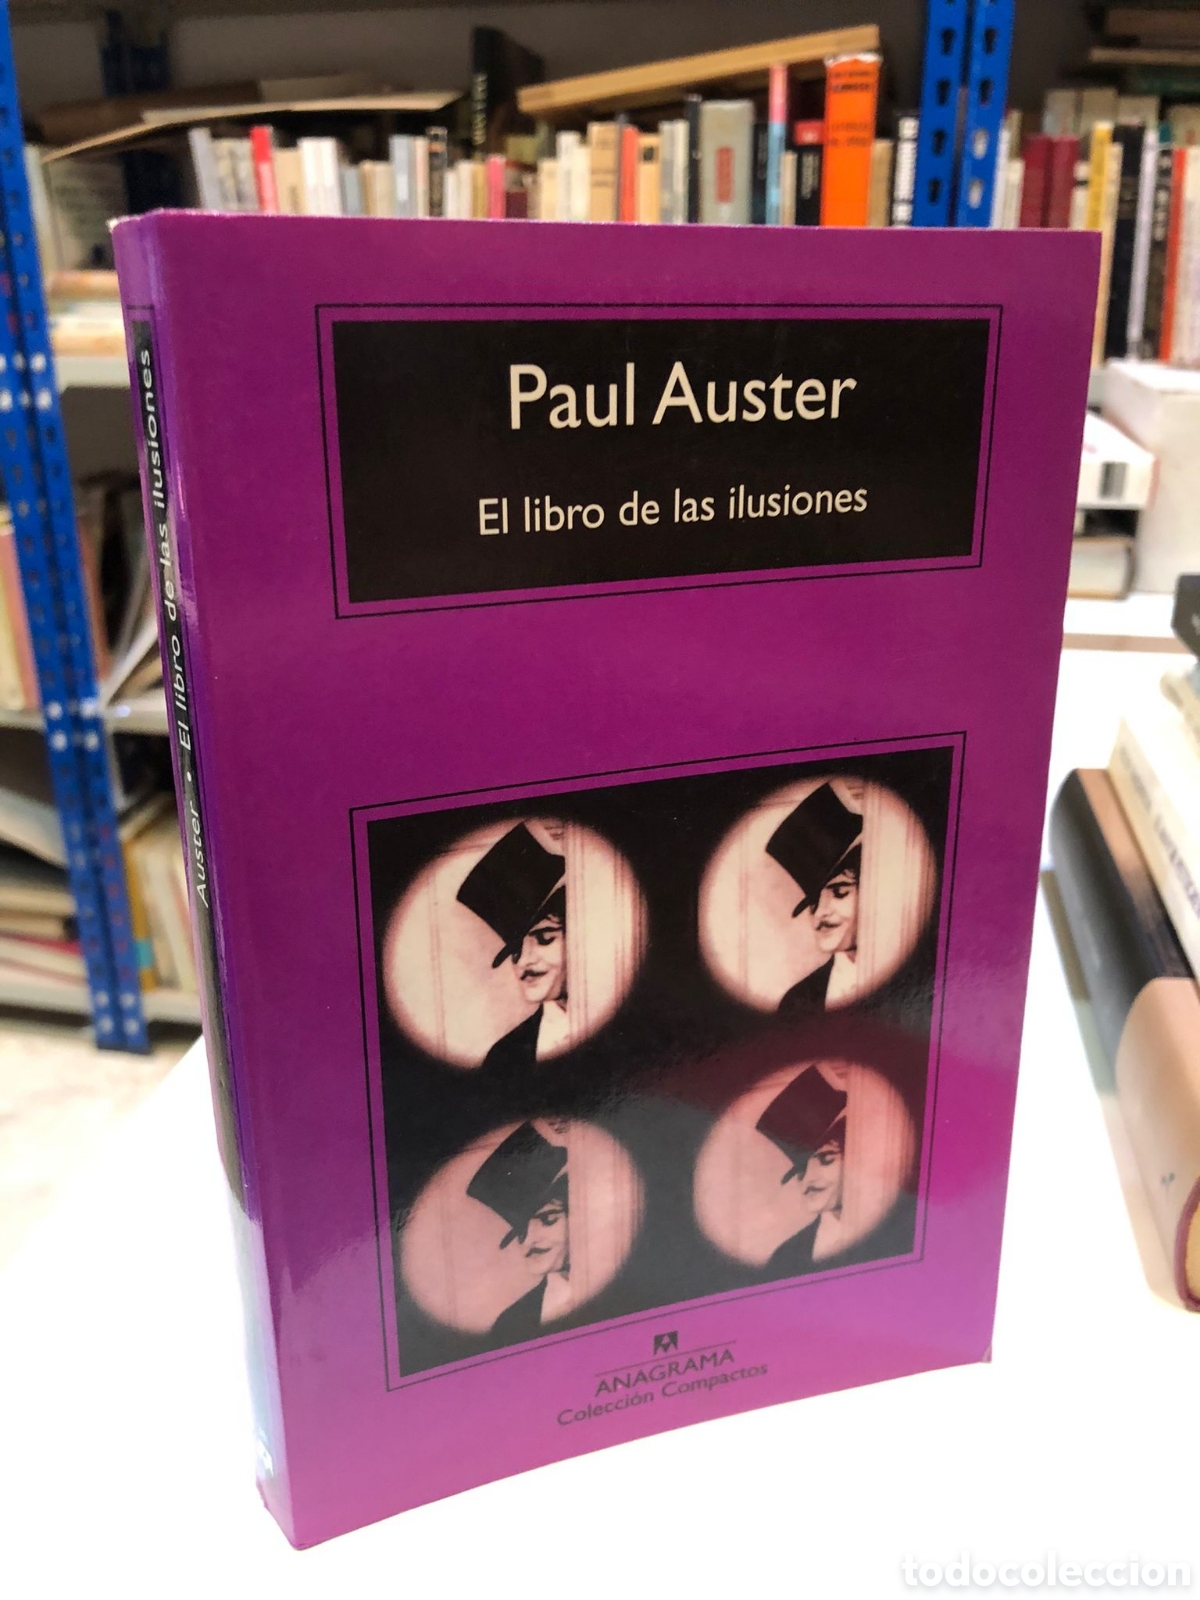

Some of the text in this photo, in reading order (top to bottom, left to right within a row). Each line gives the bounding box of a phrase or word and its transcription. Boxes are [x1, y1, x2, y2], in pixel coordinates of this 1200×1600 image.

[509, 361, 858, 430] Paul Auster
[478, 484, 868, 536] El libro de las ilusiones
[141, 350, 209, 909] Auster El libro de las ilusiones
[557, 1364, 769, 1426] Colección Compactos
[595, 1349, 735, 1397] ANAGRAMA
